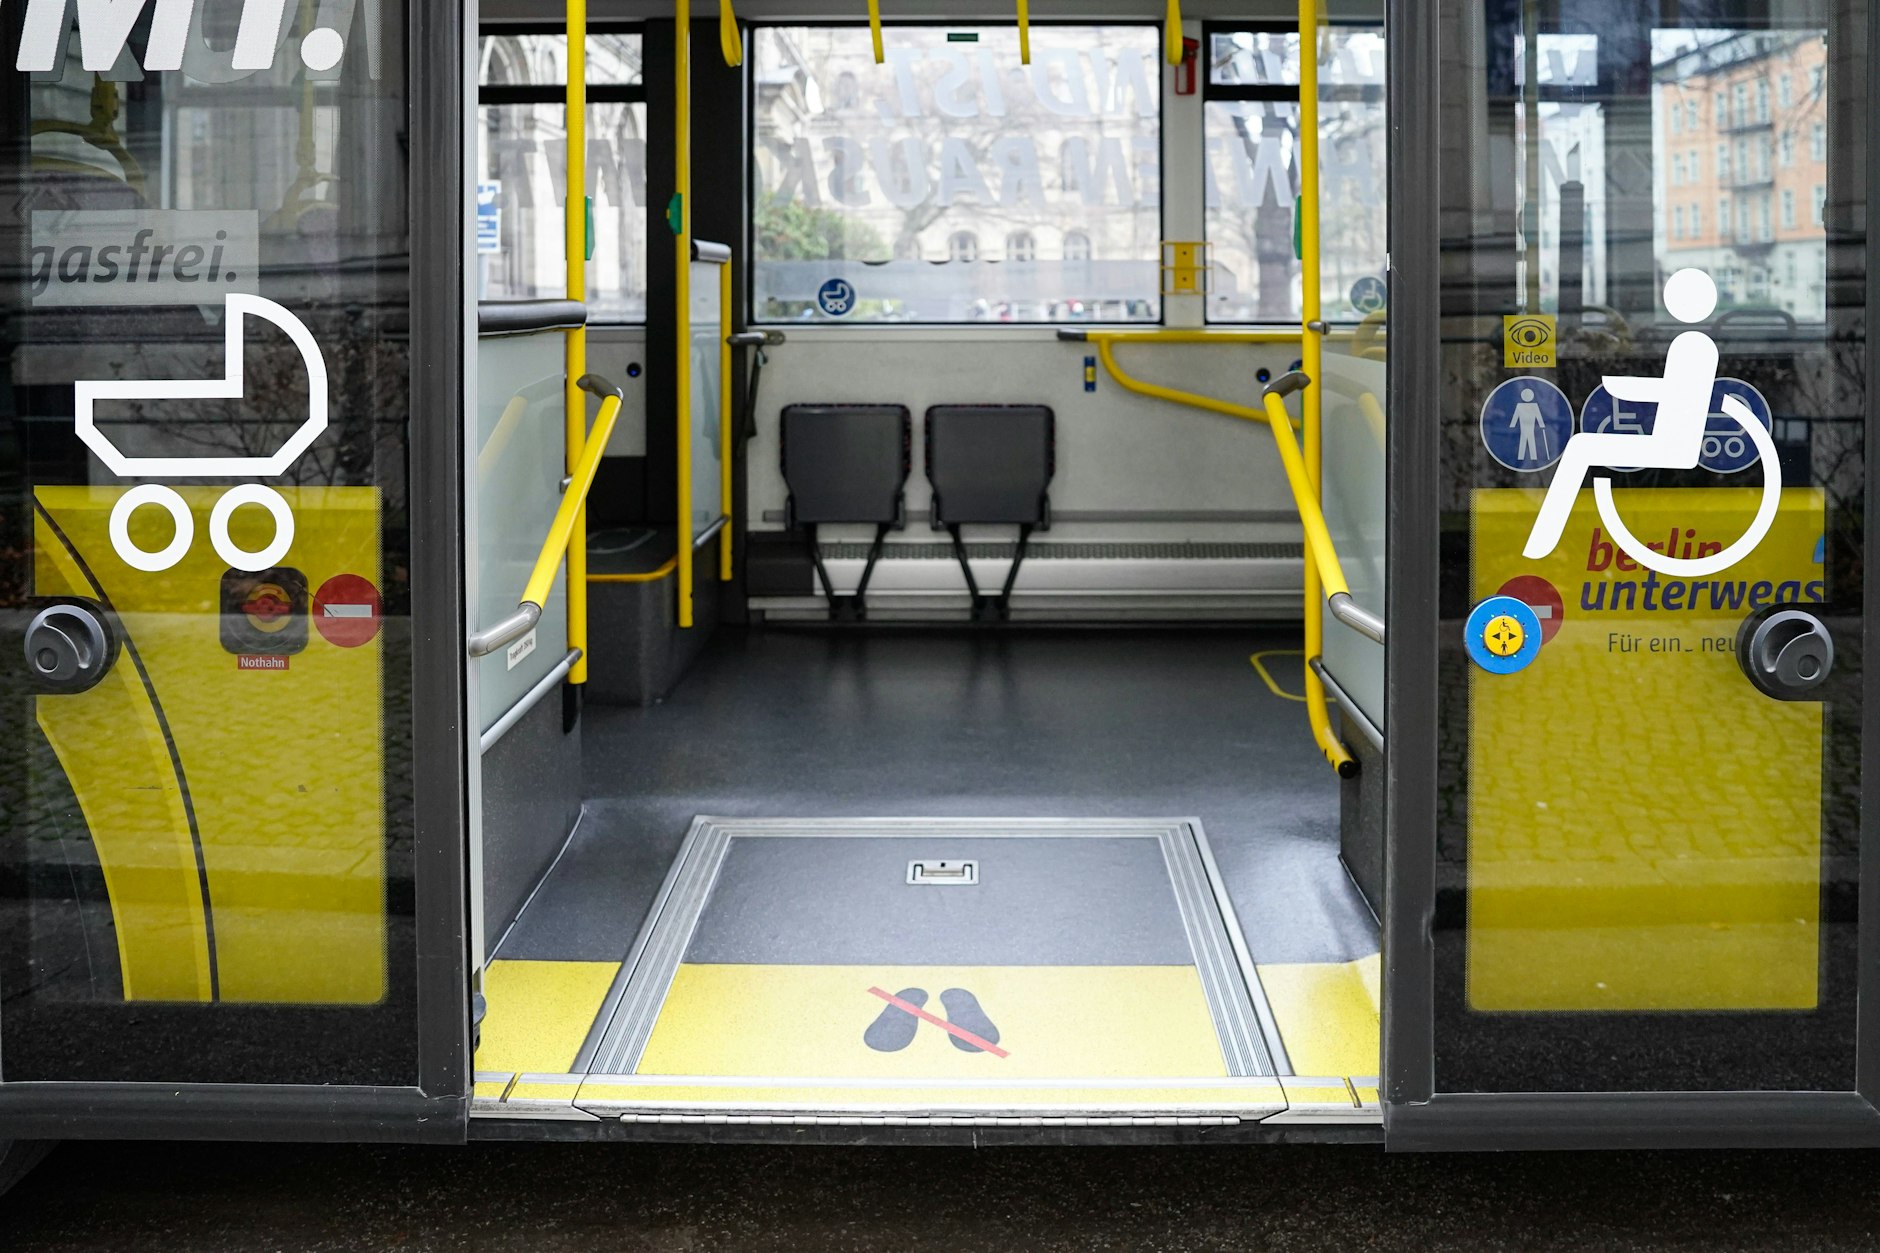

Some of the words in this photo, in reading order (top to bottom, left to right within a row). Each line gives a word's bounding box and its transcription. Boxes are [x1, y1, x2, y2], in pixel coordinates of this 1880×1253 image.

[32, 229, 237, 297] gasfrei.
[1512, 351, 1549, 364] Video
[1608, 632, 1643, 653] Für
[240, 656, 285, 669] Nothahn
